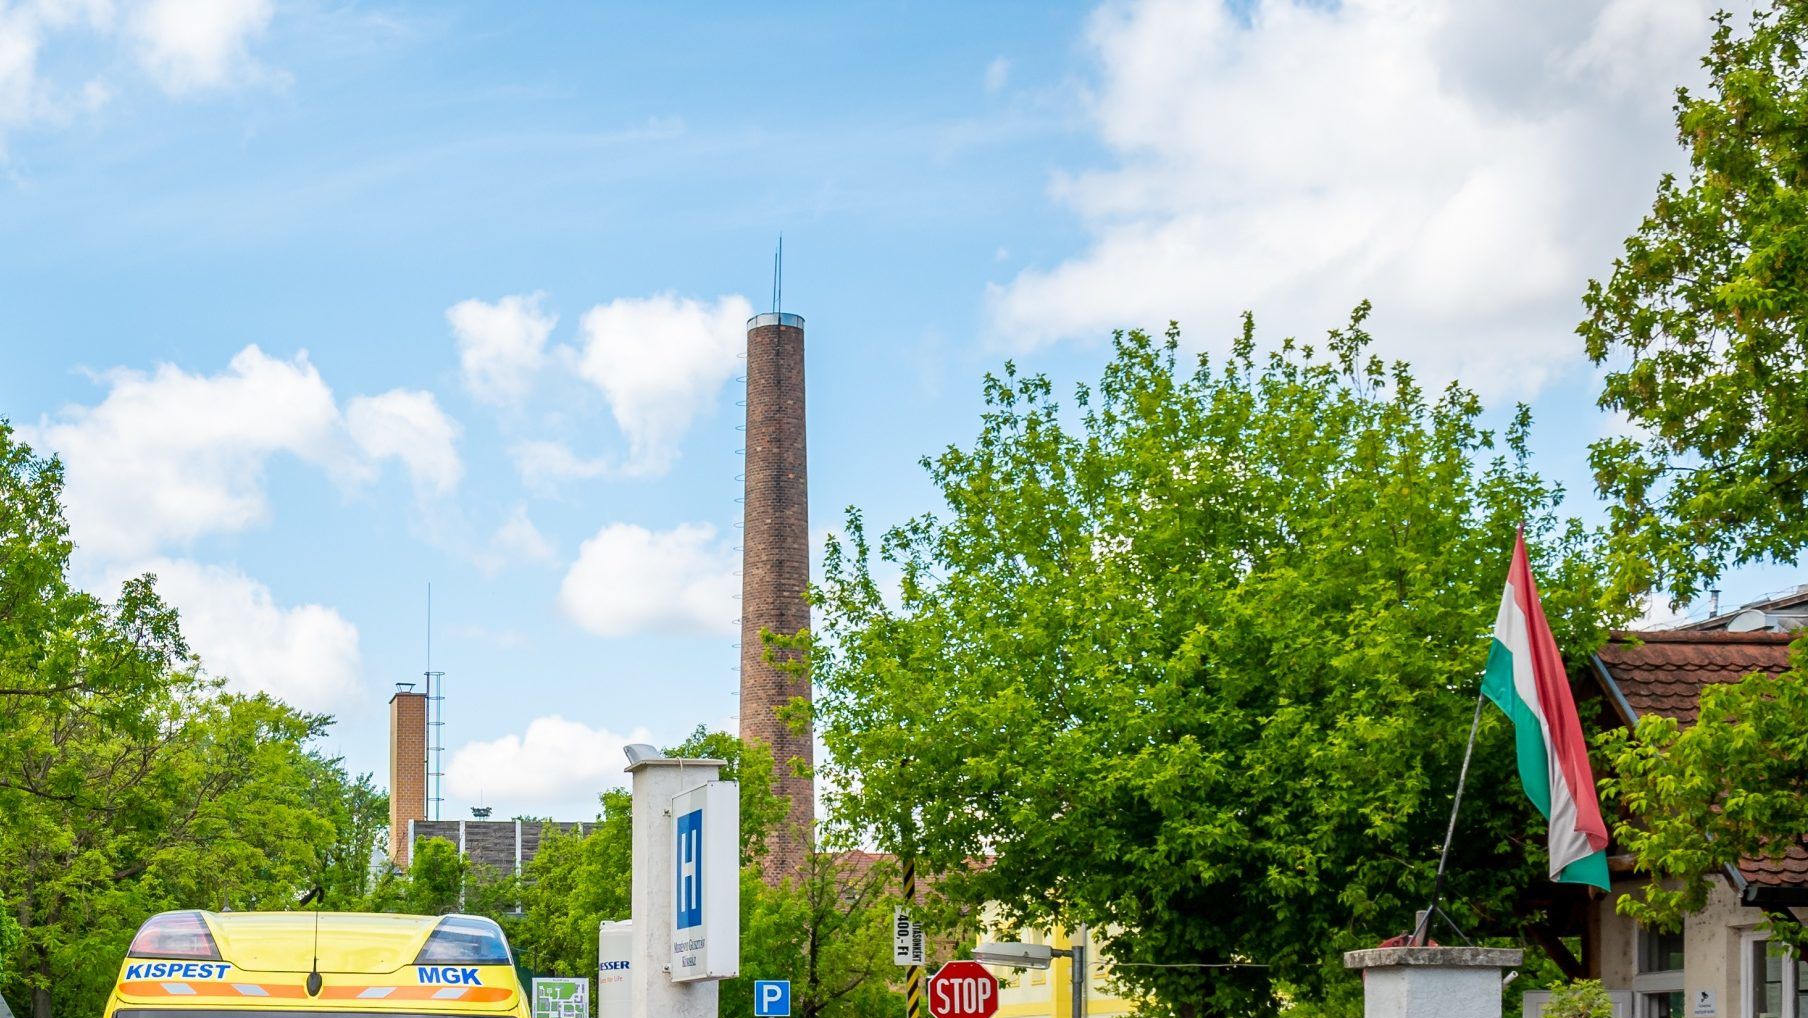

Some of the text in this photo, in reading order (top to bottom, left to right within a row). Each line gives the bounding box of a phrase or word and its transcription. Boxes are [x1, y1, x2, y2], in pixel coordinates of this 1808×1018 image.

[681, 829, 697, 913] H
[897, 946, 909, 956] Ft
[125, 963, 231, 980] KISPEST
[600, 960, 630, 971] ESSER
[417, 966, 482, 985] MGK
[763, 984, 783, 1013] P
[936, 978, 992, 1015] STOP
